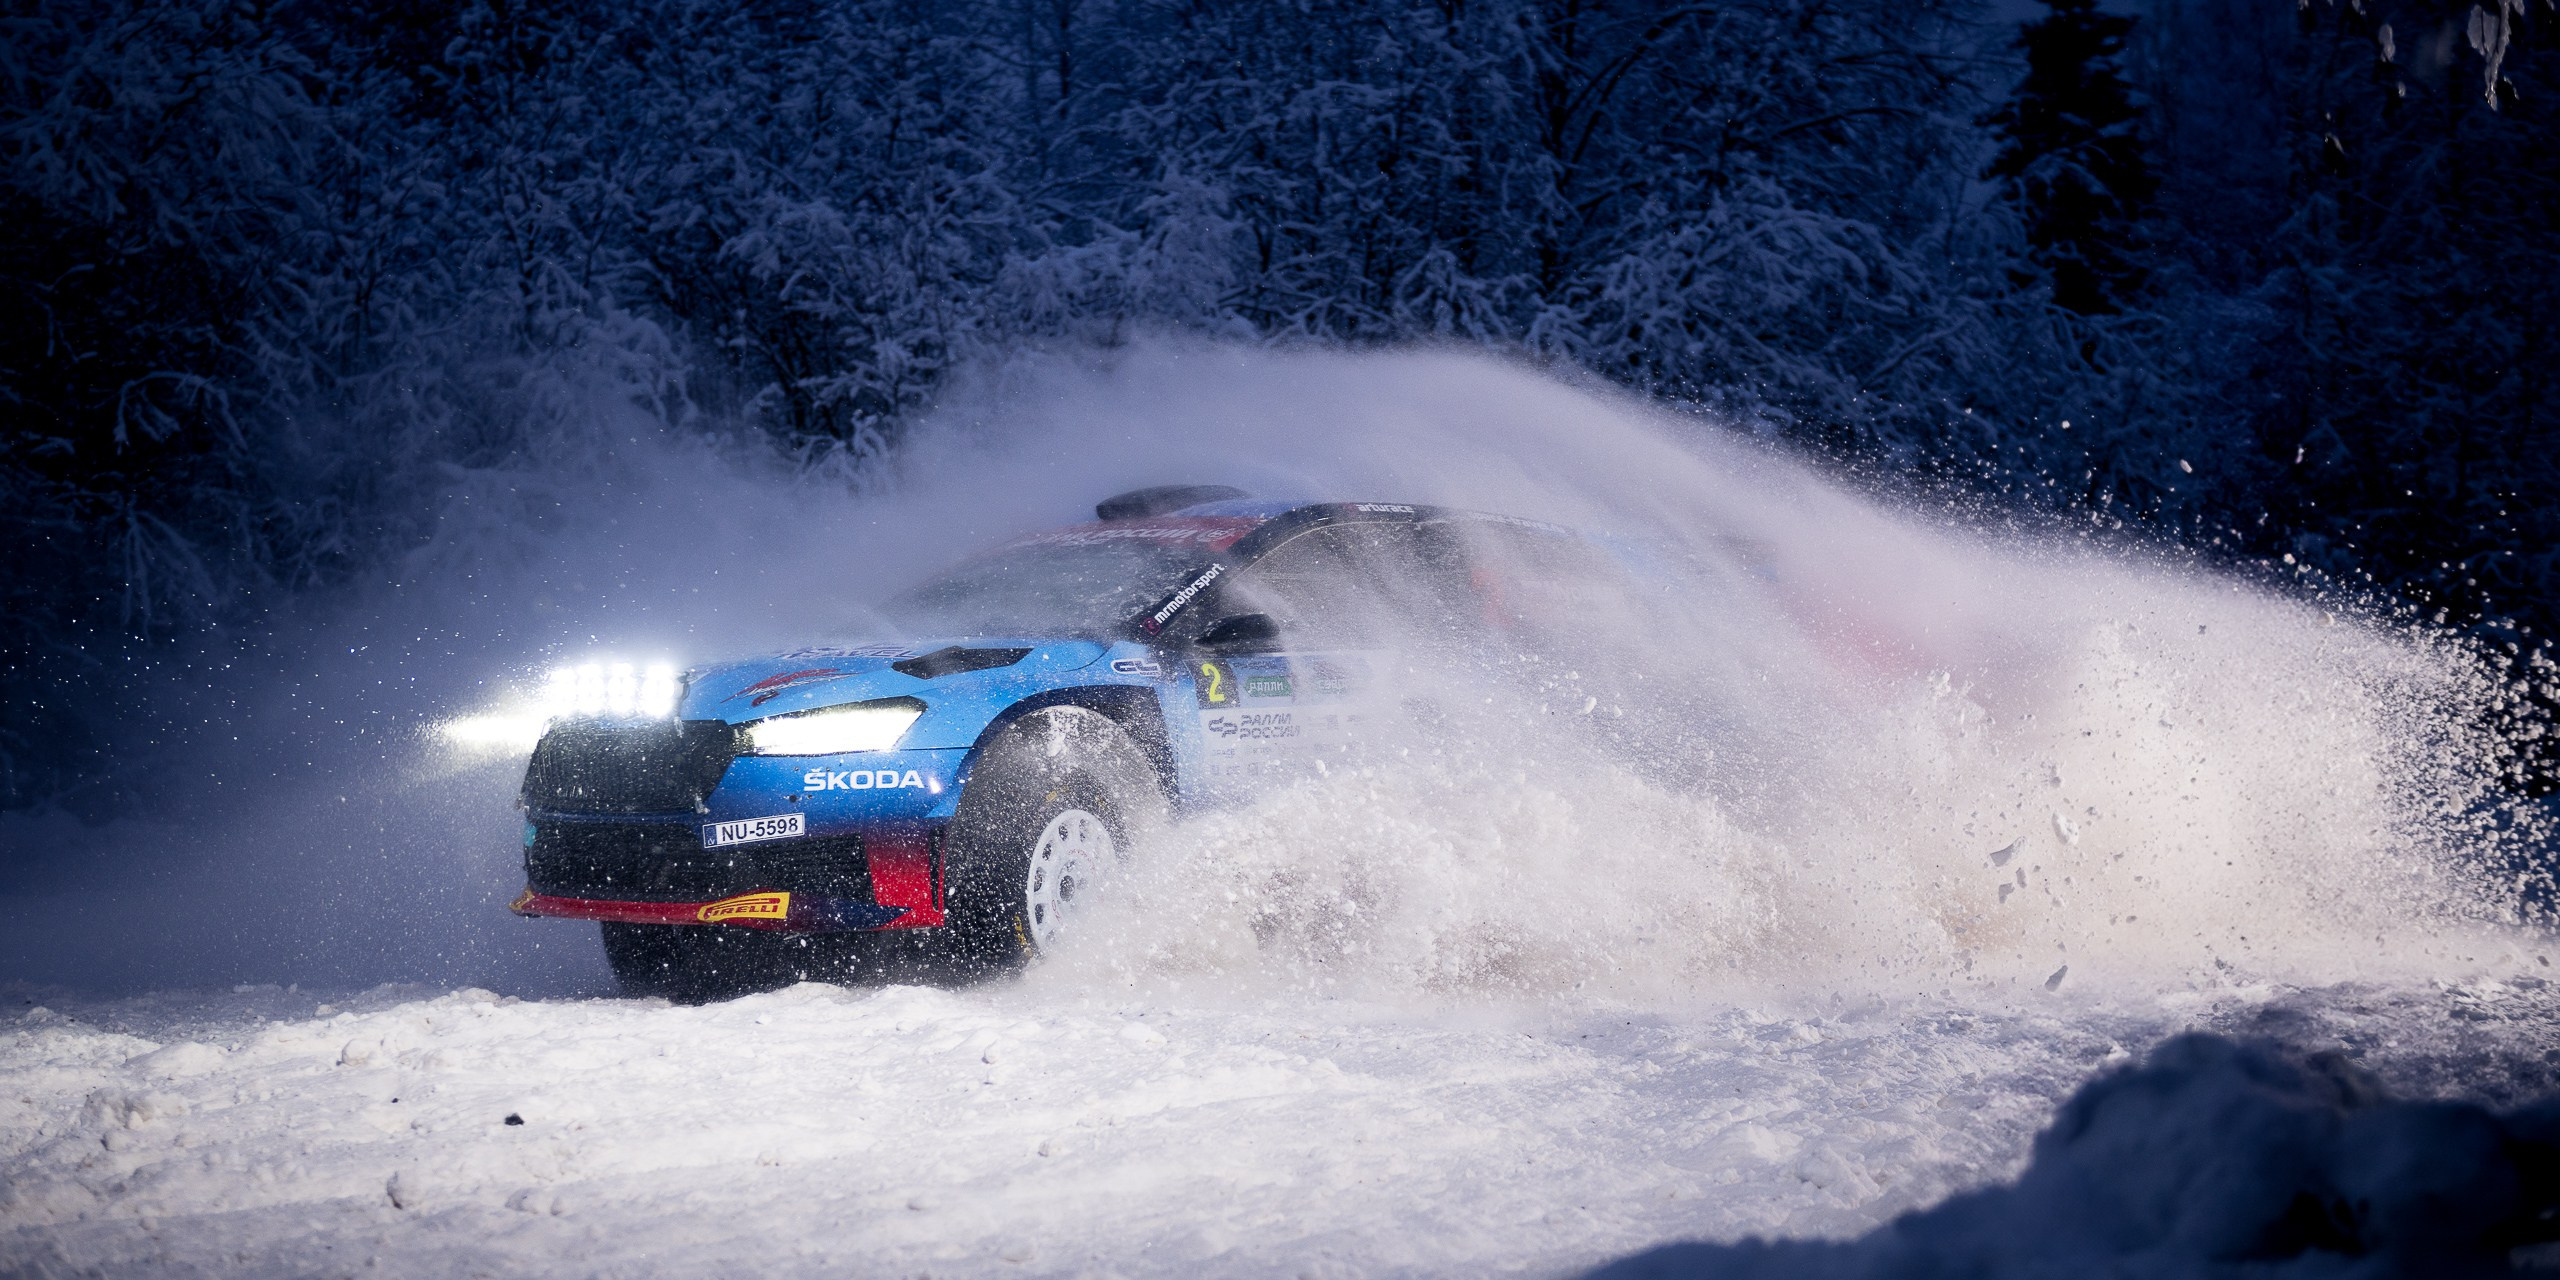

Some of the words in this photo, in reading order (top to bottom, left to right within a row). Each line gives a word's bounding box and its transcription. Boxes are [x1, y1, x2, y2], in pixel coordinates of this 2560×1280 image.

[1355, 502, 1414, 513] arturace
[1154, 563, 1225, 624] mrmotorsport
[1202, 663, 1225, 702] 2
[1240, 713, 1291, 726] РАЛЛИ
[1239, 725, 1300, 739] РОССИИ
[803, 768, 925, 791] ŠKODA
[722, 817, 799, 841] NU-5598
[703, 898, 780, 920] PIRELLI
